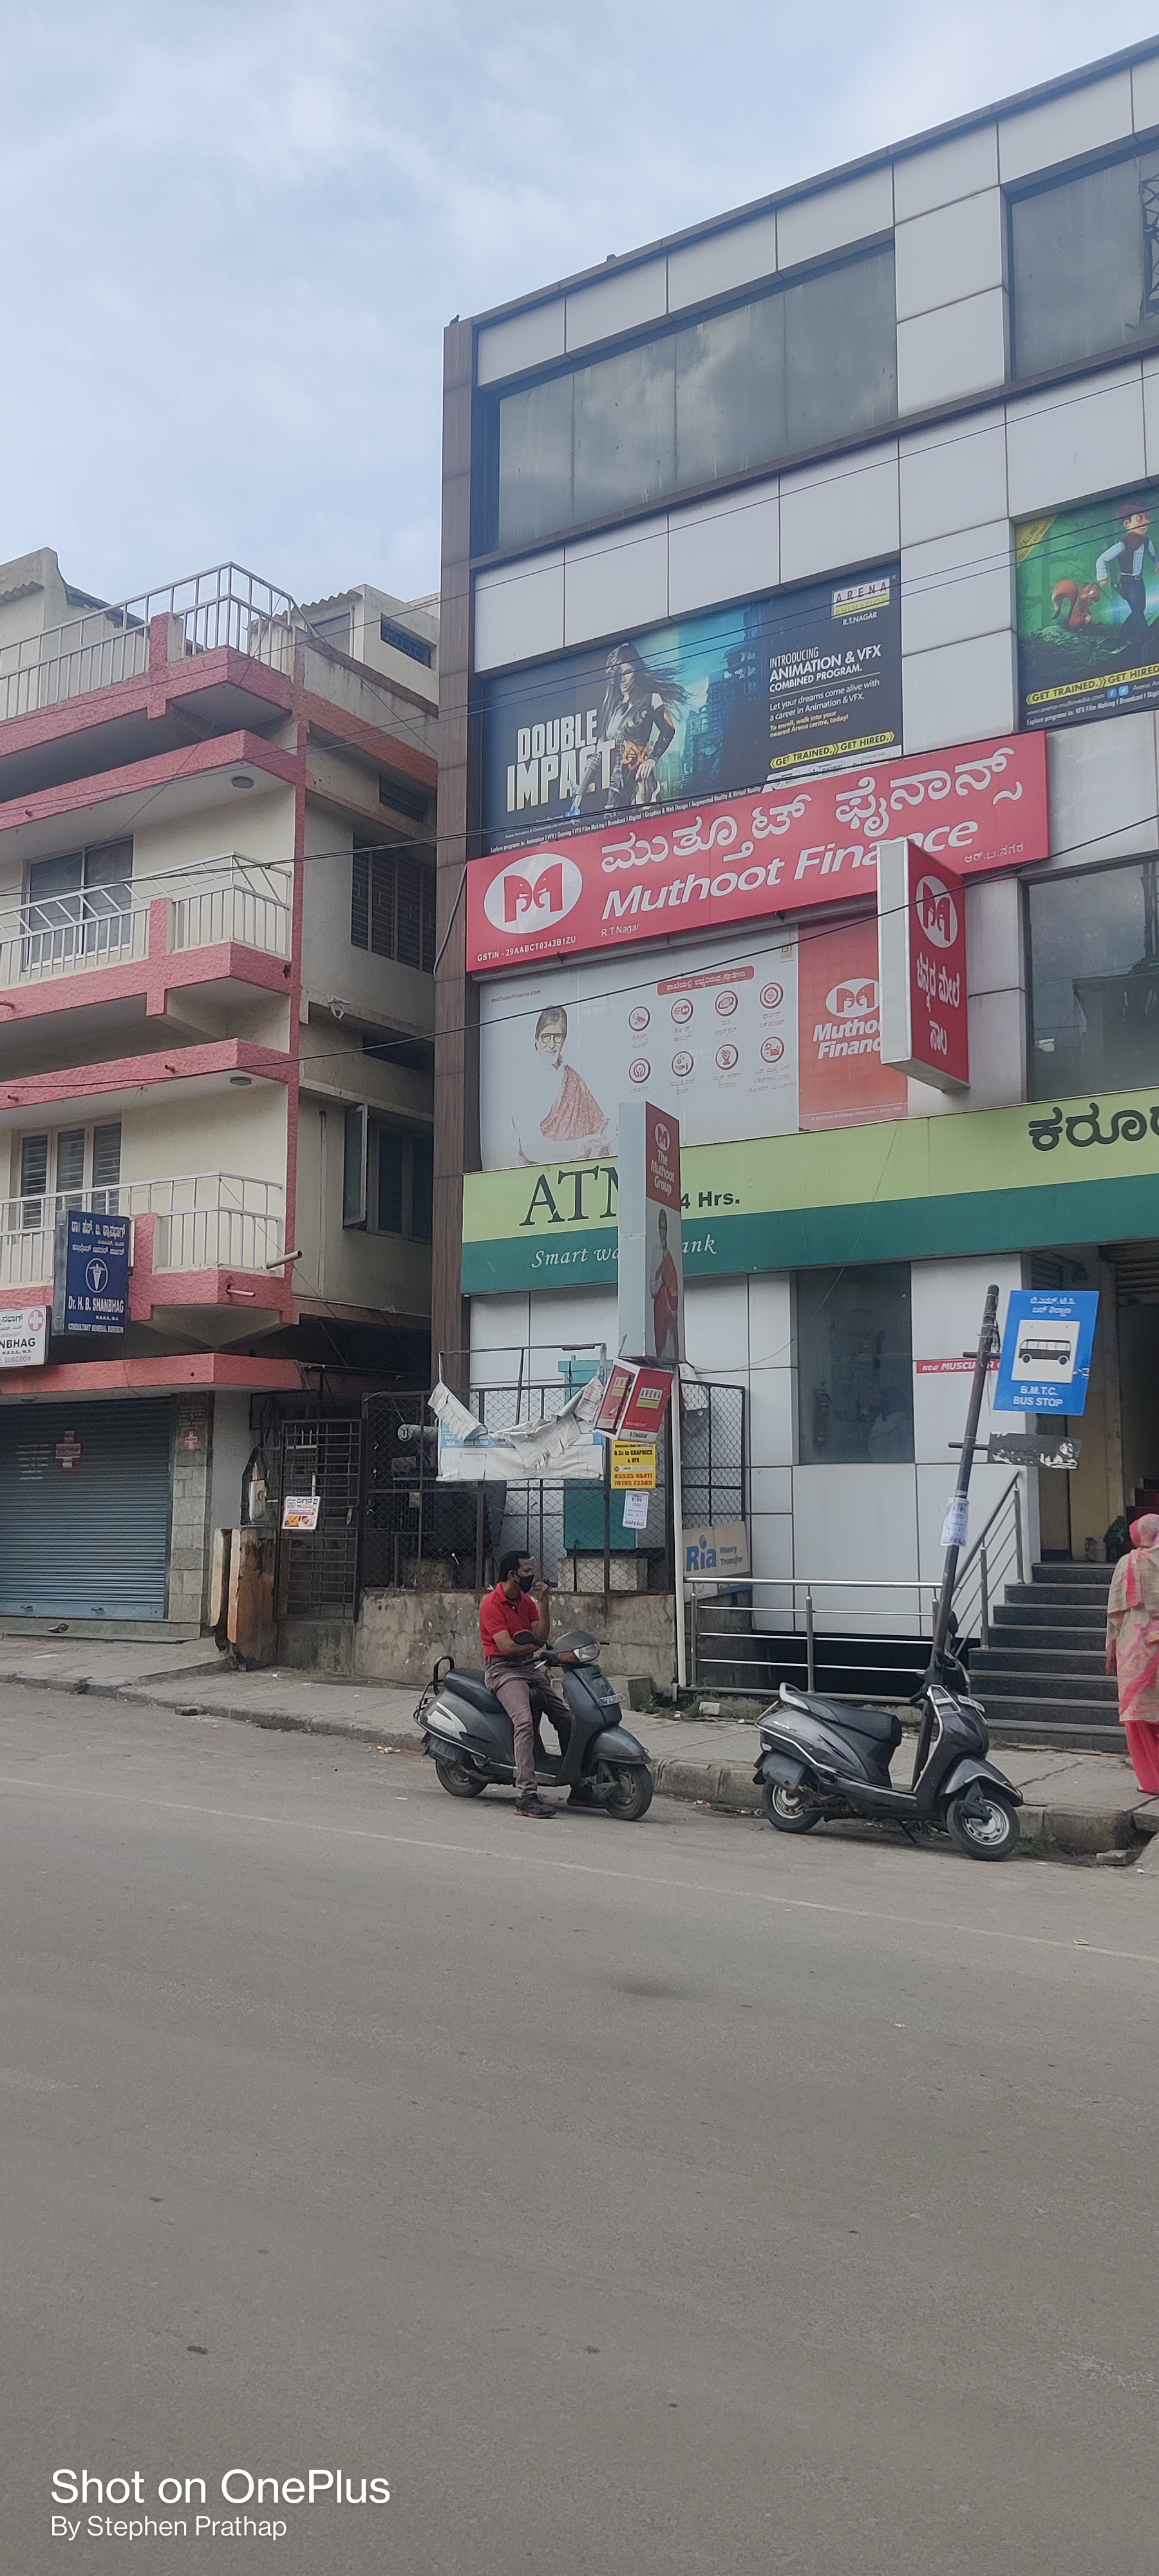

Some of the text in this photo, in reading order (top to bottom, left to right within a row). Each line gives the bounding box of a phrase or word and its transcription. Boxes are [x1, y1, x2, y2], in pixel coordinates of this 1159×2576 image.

[836, 582, 887, 603] ARENA
[769, 646, 819, 669] INTRODUCING
[769, 644, 881, 683] ANIMATION & VFX
[769, 663, 863, 693] COMBINED PROGRAM.
[1107, 673, 1127, 684] GET
[769, 678, 880, 711] Let your dreams come alive with
[1032, 680, 1098, 701] GET TRAINED.
[775, 710, 796, 720] career
[805, 697, 842, 712] Animation
[849, 692, 865, 703] VFX.
[1026, 716, 1044, 726] Explore
[1045, 711, 1067, 721] programs
[1086, 704, 1097, 712] Film
[1097, 701, 1116, 710] Making
[769, 714, 849, 738] nearest Arena centre, today!
[777, 720, 795, 730] enroll,
[796, 715, 809, 724] walk
[823, 711, 837, 720] your
[517, 708, 598, 763] DOUBLE
[840, 734, 889, 751] GET HIRED.
[775, 746, 833, 766] GET TRAINED.
[507, 739, 615, 813] IMPACT
[490, 845, 503, 853] Explore
[504, 842, 520, 851] programs
[526, 836, 545, 846] Animation
[547, 833, 555, 841] VFX
[558, 829, 572, 838] Gaming
[582, 824, 590, 833] Film
[590, 822, 605, 831] Making
[629, 813, 642, 822] Digital
[645, 808, 661, 818] Graphics
[692, 796, 713, 808] Augmented
[714, 793, 728, 802] Reality
[733, 788, 746, 797] Virtual
[747, 786, 762, 794] Reality
[601, 747, 1022, 873] ಮುತ್ತೂಟ್ ಫೈನಾನ್ಸ್
[601, 857, 786, 920] Muthoot
[616, 923, 640, 934] Nagar
[477, 951, 500, 962] GSTIN
[505, 935, 576, 956] 29AABCT0343B1ZU
[491, 990, 541, 1003] muthootfinance.com
[813, 1019, 881, 1042] Mutho
[818, 1037, 883, 1060] Financ
[657, 1150, 668, 1166] The
[651, 1159, 675, 1182] Muthoot
[654, 1176, 672, 1196] Group
[698, 1189, 740, 1208] Hrs.
[531, 1247, 587, 1269] Smart
[593, 1247, 619, 1262] wa
[78, 1296, 84, 1310] H.
[85, 1296, 91, 1311] B.
[92, 1297, 124, 1313] SHANBHAG
[68, 1322, 91, 1331] CONSULTANT
[91, 1324, 108, 1332] GENERAL
[0, 1338, 35, 1349] NBHAG
[5, 1355, 32, 1363] SURGEON
[641, 1389, 661, 1399] ARENA
[1013, 1396, 1064, 1406] BUS STOP
[1020, 1385, 1058, 1396] B.M.T.C.
[686, 1535, 717, 1571] Ria
[721, 1555, 743, 1565] Transfer
